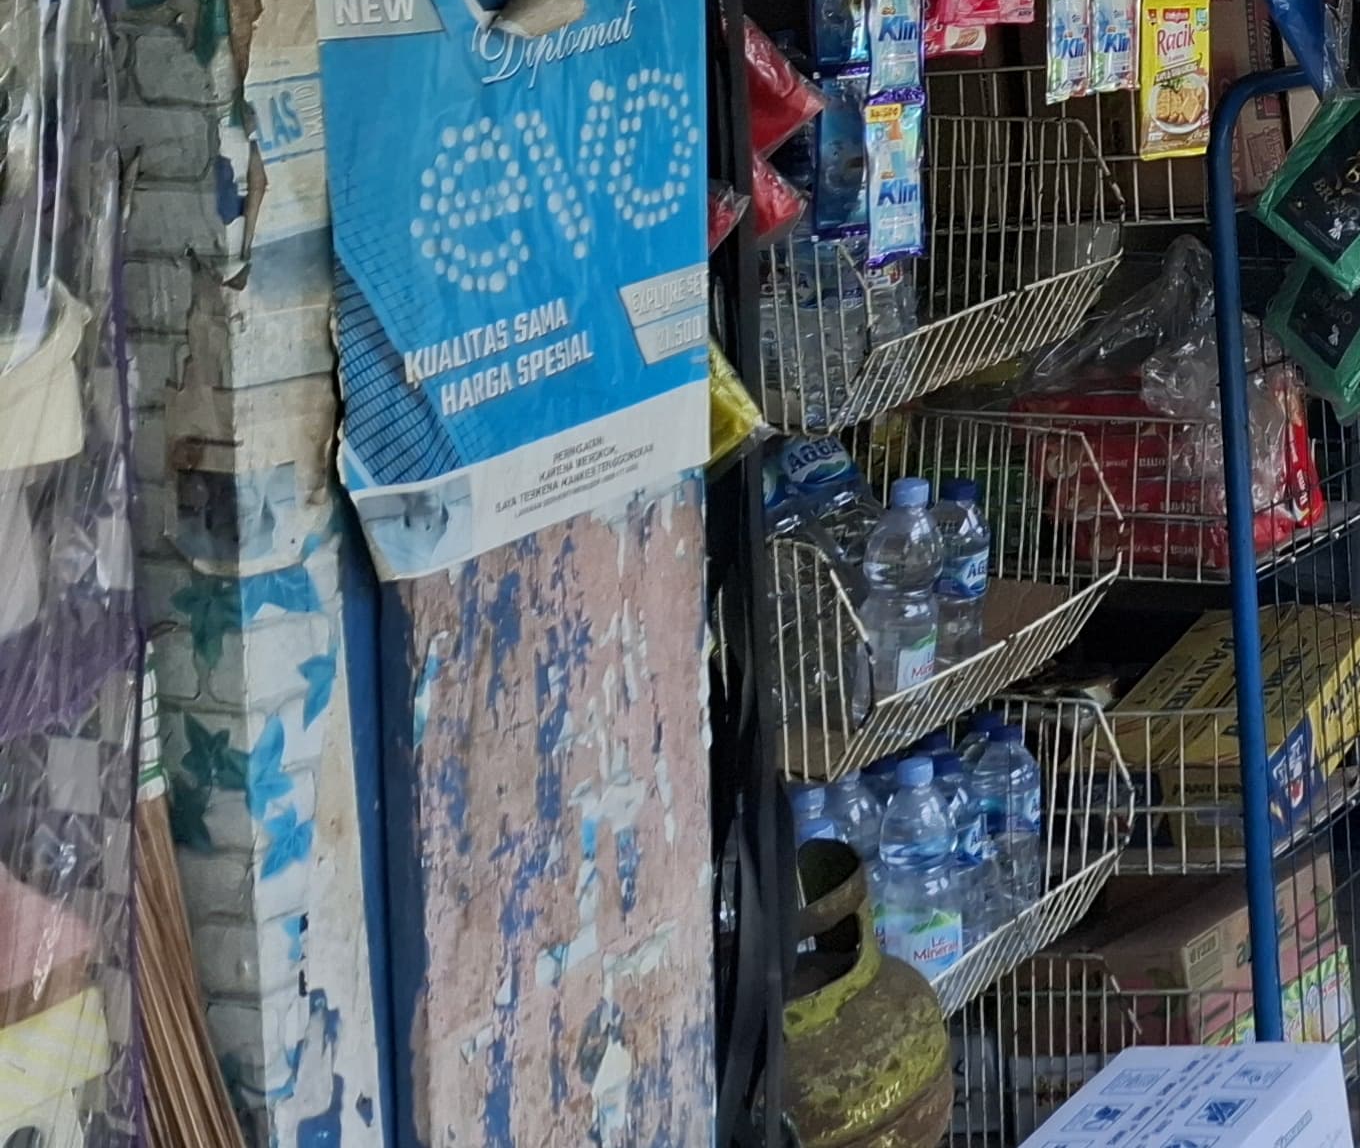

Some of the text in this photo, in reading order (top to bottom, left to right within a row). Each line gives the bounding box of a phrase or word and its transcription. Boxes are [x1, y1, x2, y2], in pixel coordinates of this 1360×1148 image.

[471, 0, 636, 89] Diplomat
[1157, 23, 1195, 56] Racik
[410, 68, 698, 293] evo
[404, 298, 569, 385] KUALITAS SAMA
[440, 330, 594, 416] HARGA SPESIAL
[786, 436, 844, 474] AQUA
